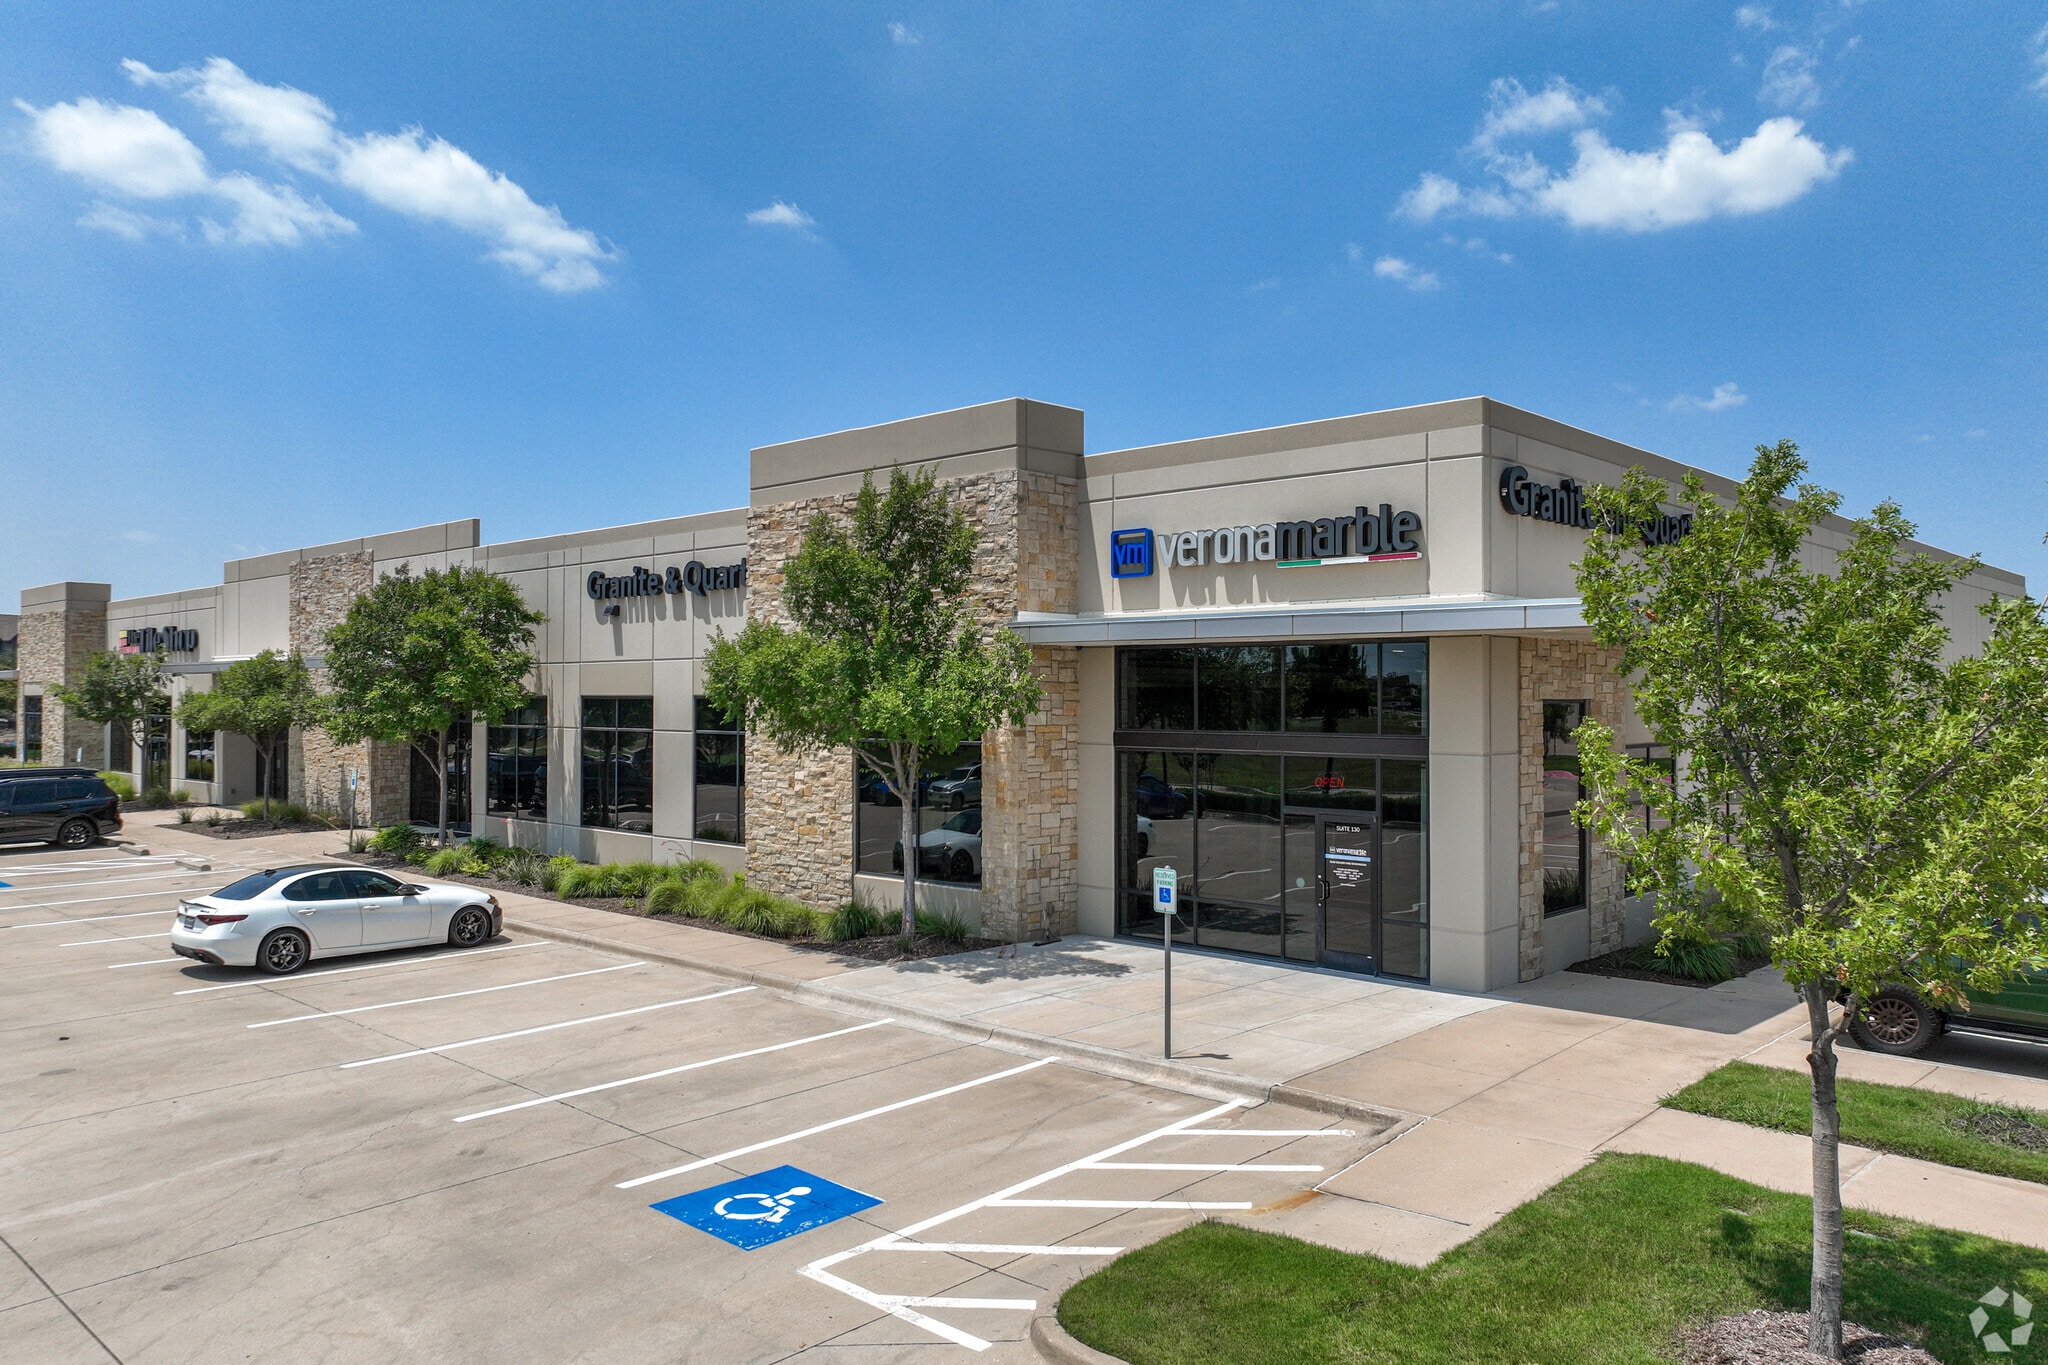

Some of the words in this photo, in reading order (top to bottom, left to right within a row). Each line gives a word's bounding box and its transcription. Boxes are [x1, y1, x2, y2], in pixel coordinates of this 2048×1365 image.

[1157, 504, 1421, 568] veronamarble
[1114, 542, 1146, 565] vm
[587, 566, 664, 600] Granite
[664, 566, 683, 594] &
[1314, 776, 1345, 788] OPEN
